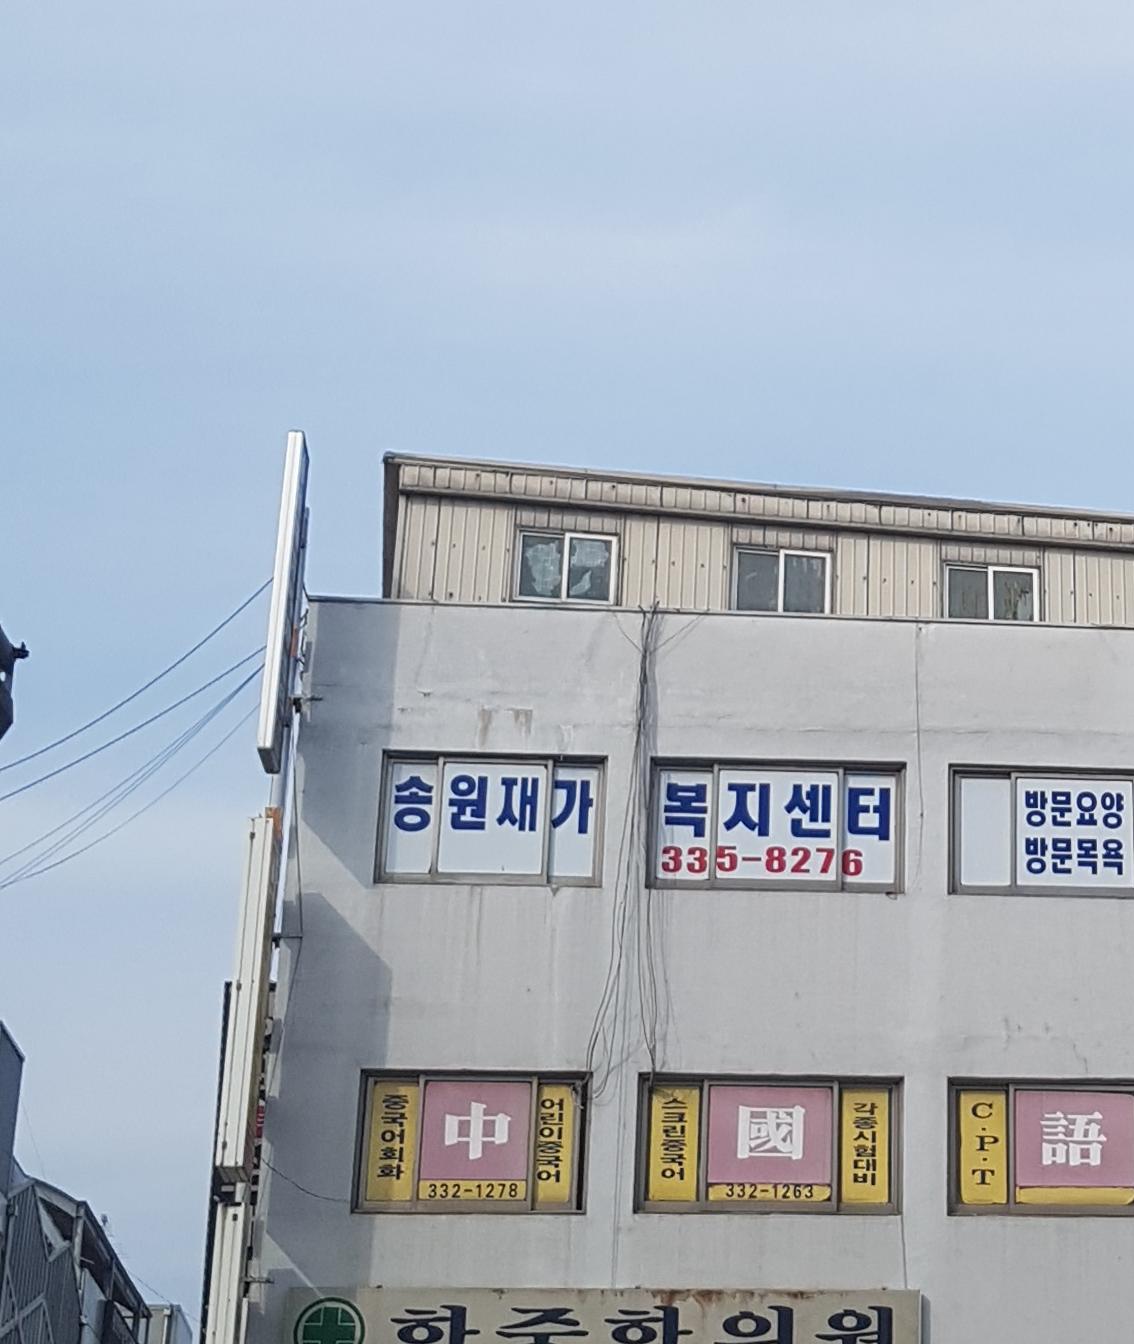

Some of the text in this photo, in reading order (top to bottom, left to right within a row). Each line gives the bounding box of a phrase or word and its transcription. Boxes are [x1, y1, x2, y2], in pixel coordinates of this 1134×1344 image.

[393, 774, 892, 841] 송원재가 복지센터
[1024, 790, 1125, 829] 방문요양
[661, 845, 864, 876] 335-8276
[1024, 837, 1124, 875] 방문목욕
[377, 1094, 409, 1180] 중국어회화
[444, 1101, 1107, 1167] 中 國 語
[537, 1098, 564, 1183] 어린이중국어
[660, 1098, 688, 1181] 스크린중국어
[852, 1103, 879, 1186] 각종시험대비
[428, 1184, 518, 1198] 332-1278
[726, 1184, 814, 1199] 332-1263
